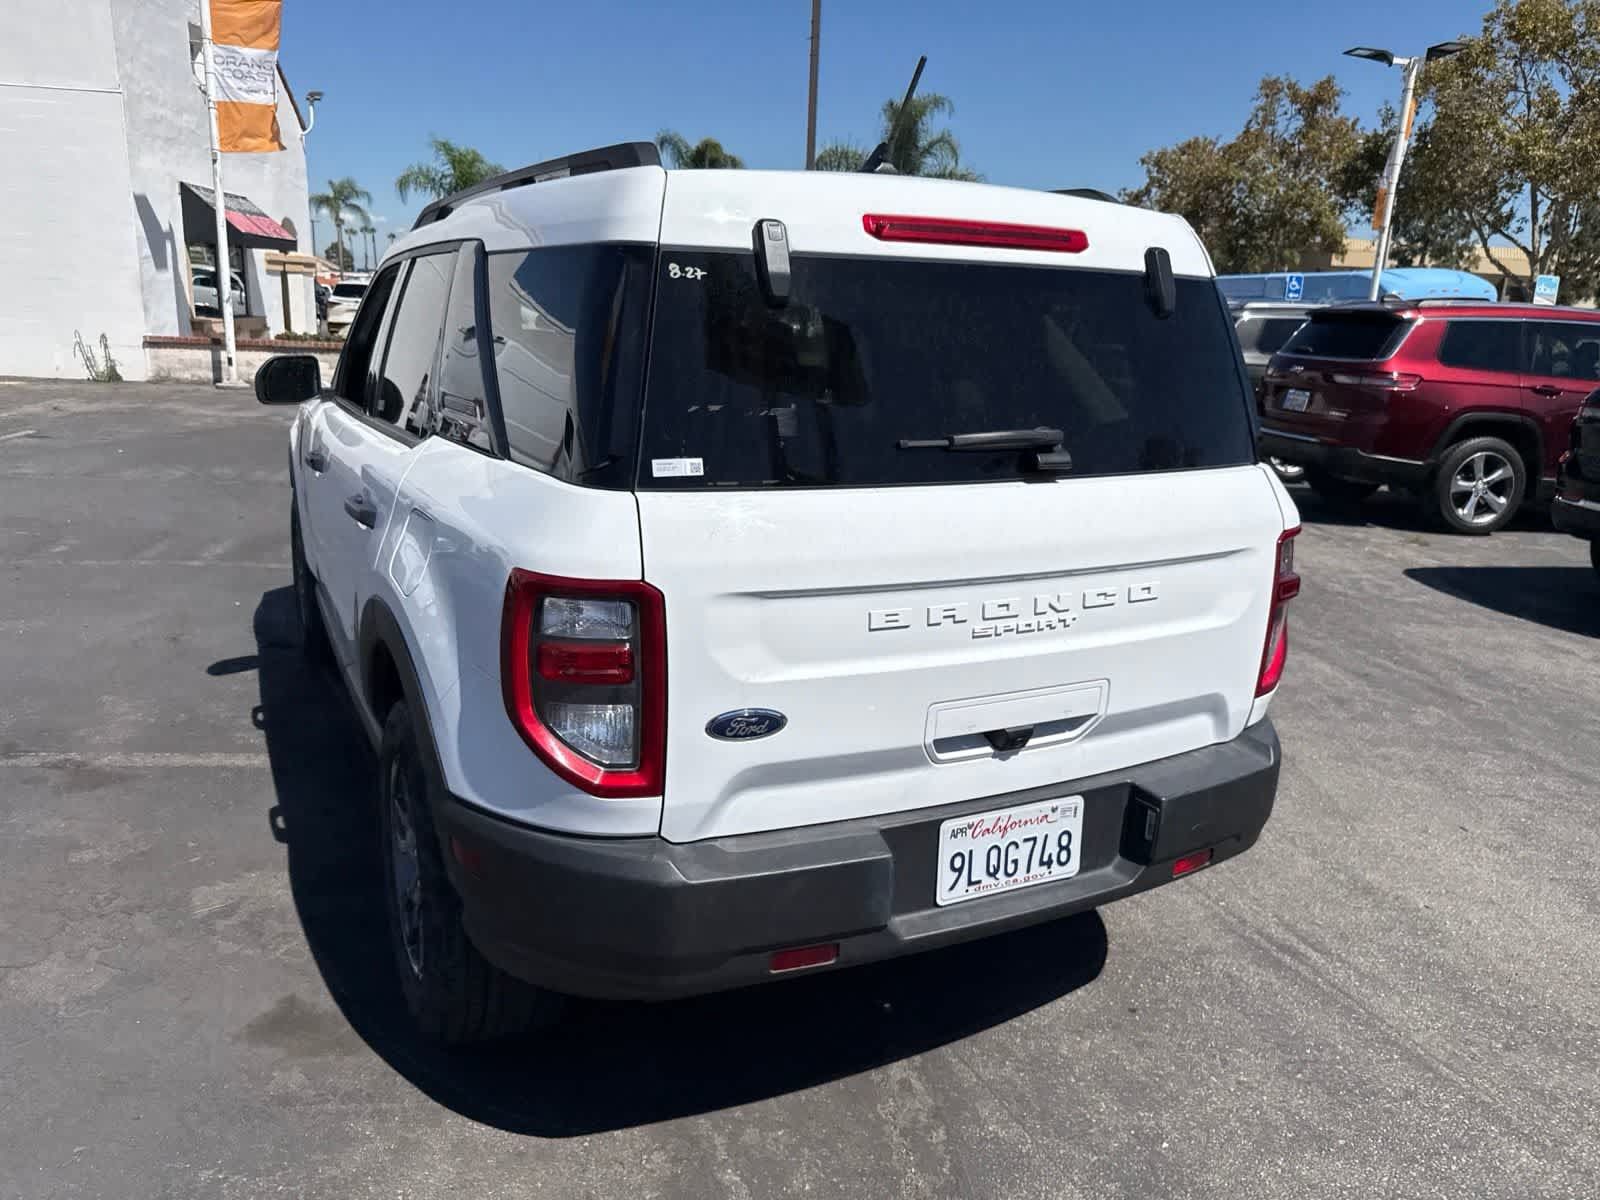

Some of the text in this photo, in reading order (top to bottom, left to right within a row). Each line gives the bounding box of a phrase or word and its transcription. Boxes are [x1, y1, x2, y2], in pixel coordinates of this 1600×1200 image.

[213, 54, 274, 71] ORANG
[867, 581, 1161, 632] BRONCO
[971, 615, 1078, 639] SPORT
[725, 717, 769, 737] Ford
[950, 814, 1057, 840] APR California
[948, 829, 1073, 892] 9LQG748
[974, 872, 1047, 893] dmv.ca.gov
